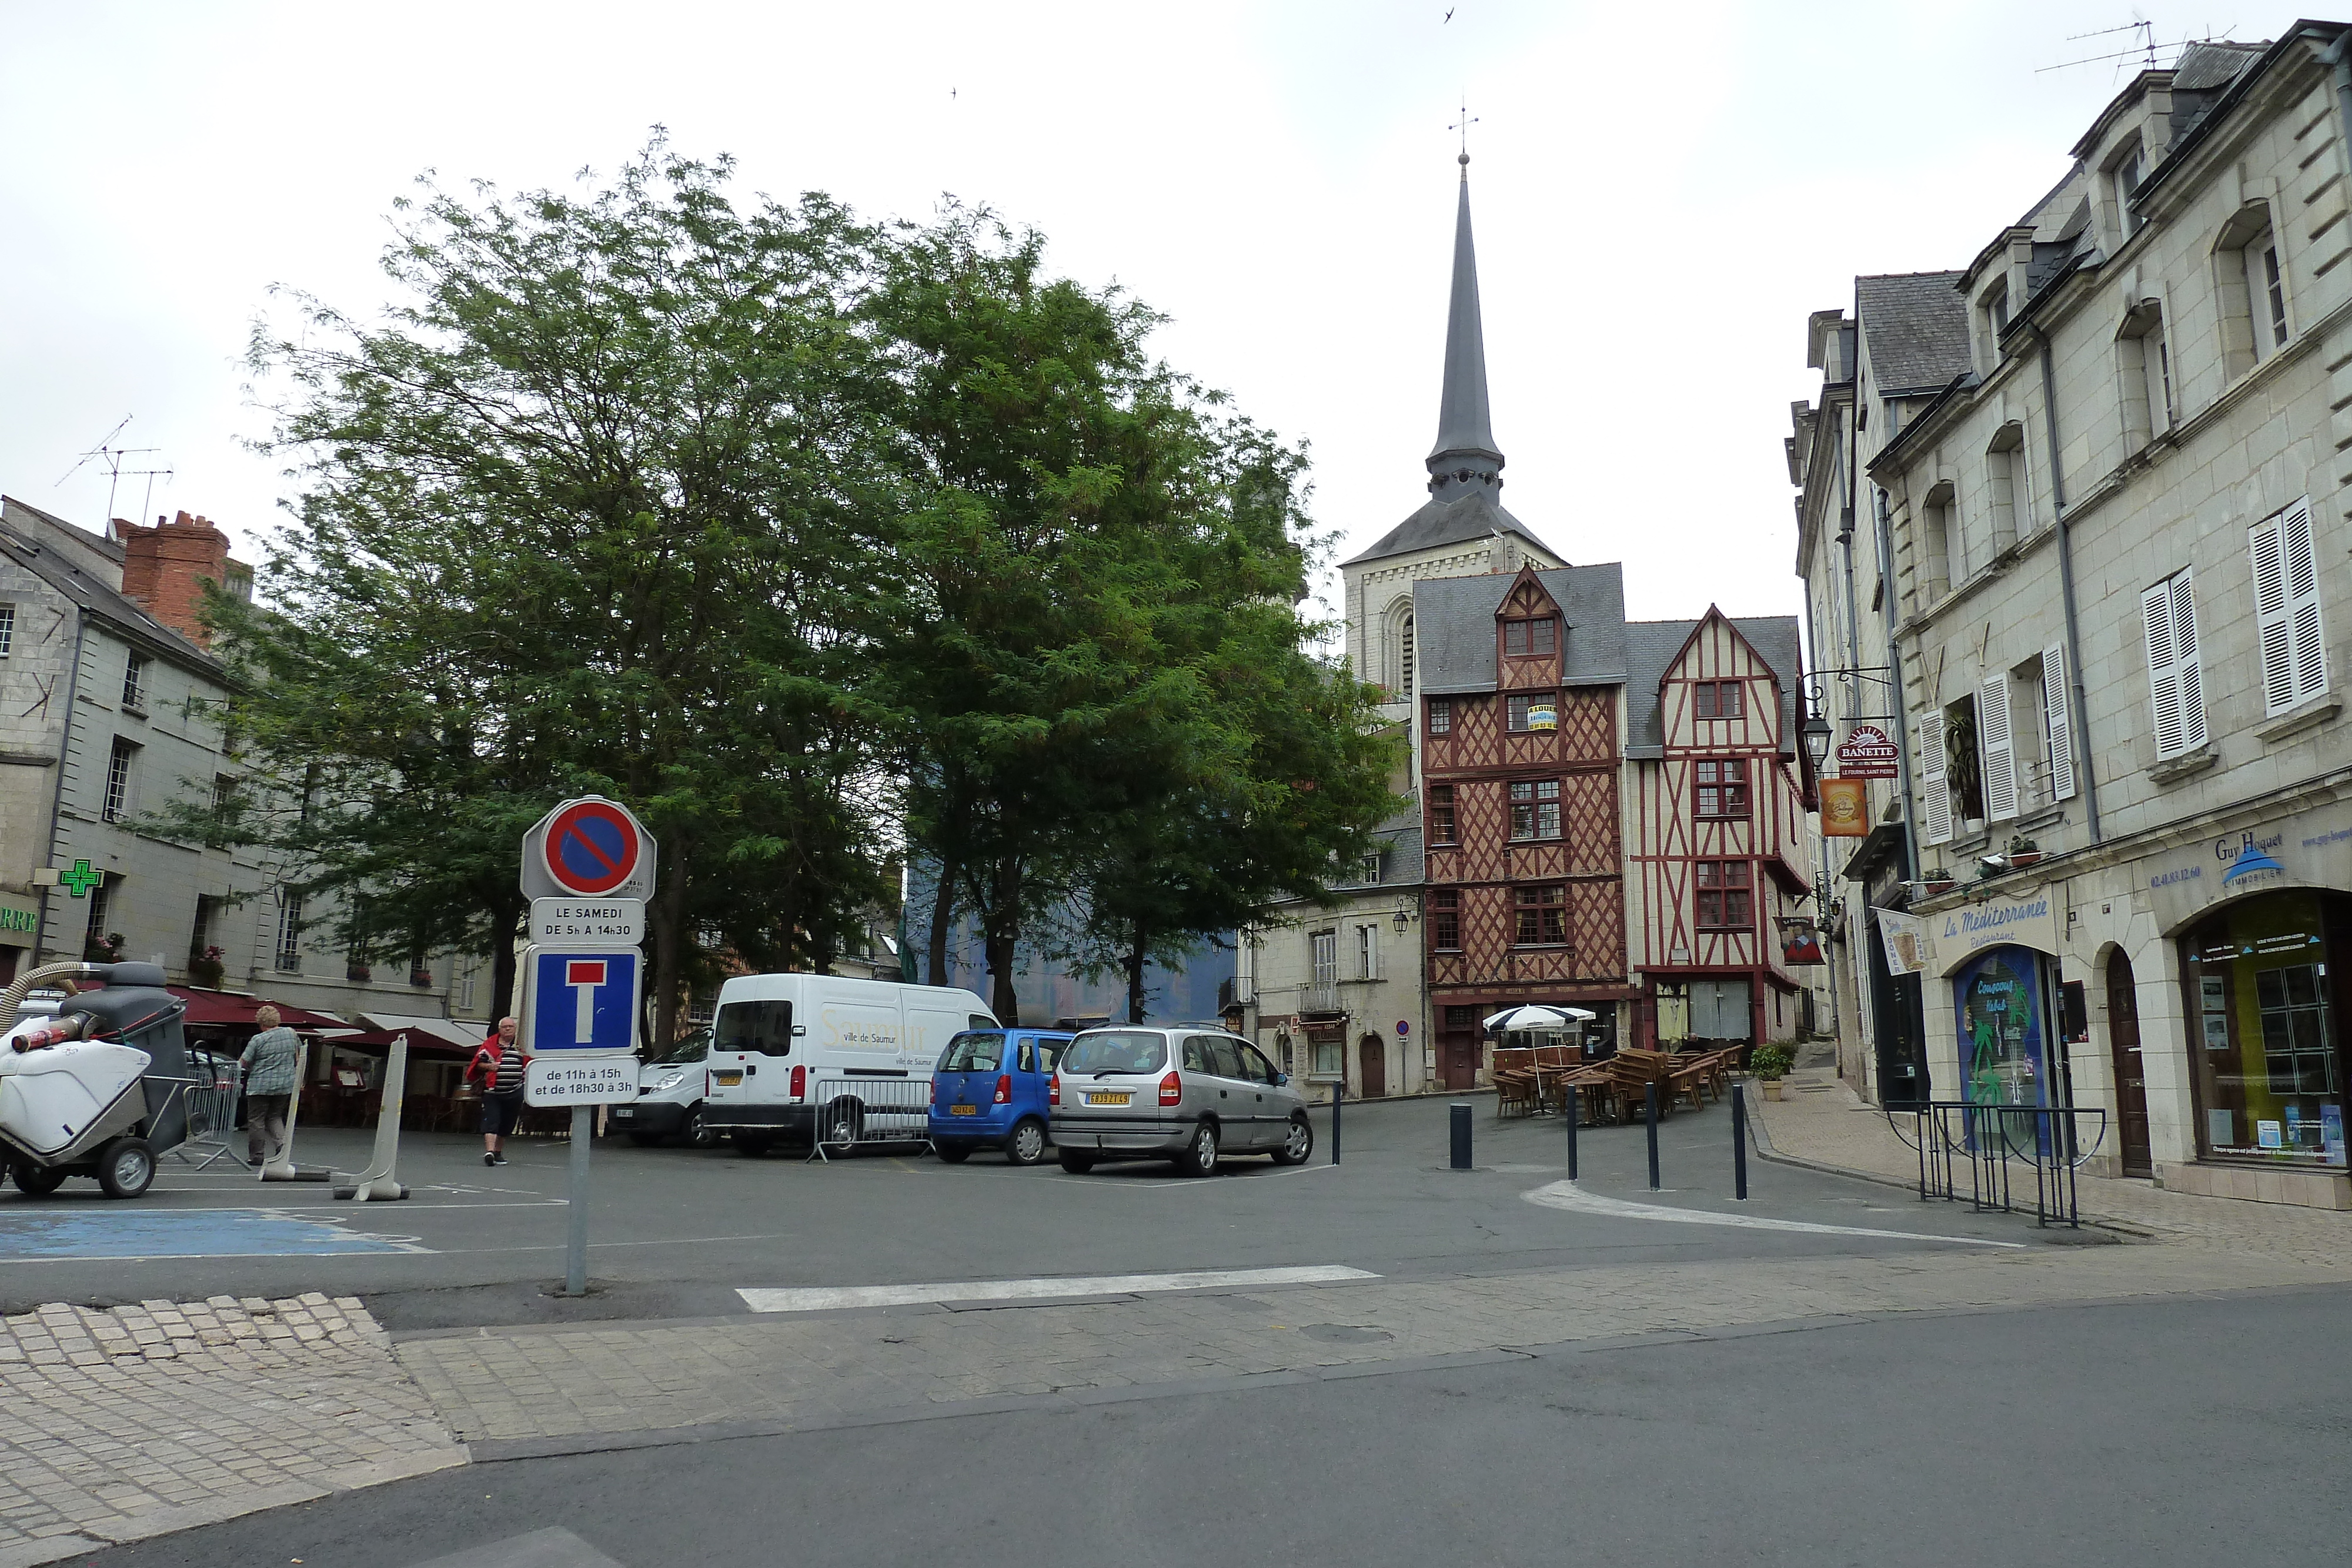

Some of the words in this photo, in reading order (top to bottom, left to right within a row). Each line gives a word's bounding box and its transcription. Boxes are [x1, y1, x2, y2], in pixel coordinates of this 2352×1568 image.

[1842, 747, 1894, 757] BANETTE
[2215, 839, 2240, 861] Guy
[2241, 831, 2283, 854] Hoquet
[2224, 868, 2281, 888] L'IMMOBILIER
[556, 908, 570, 918] LE
[576, 908, 622, 918] SAMEDI
[1943, 915, 1958, 938] La
[1962, 894, 2047, 934] Méditerranée
[546, 925, 562, 935] DE
[567, 925, 580, 935] 5h
[584, 925, 592, 935] A
[597, 925, 631, 935] 14h30
[1970, 931, 2016, 949] Restaurant
[821, 1009, 927, 1051] Saumur
[844, 1032, 857, 1042] ville
[860, 1033, 869, 1042] de
[871, 1034, 896, 1044] Saumur
[547, 1070, 562, 1080] de
[566, 1069, 586, 1079] 11h
[590, 1069, 596, 1079] à
[600, 1068, 621, 1078] 15h
[536, 1085, 547, 1095] et
[550, 1085, 565, 1094] de
[569, 1083, 604, 1094] 18h30
[607, 1082, 614, 1092] à
[617, 1082, 632, 1092] 3h
[1091, 1095, 1108, 1103] 6839
[1119, 1095, 1128, 1103] 49
